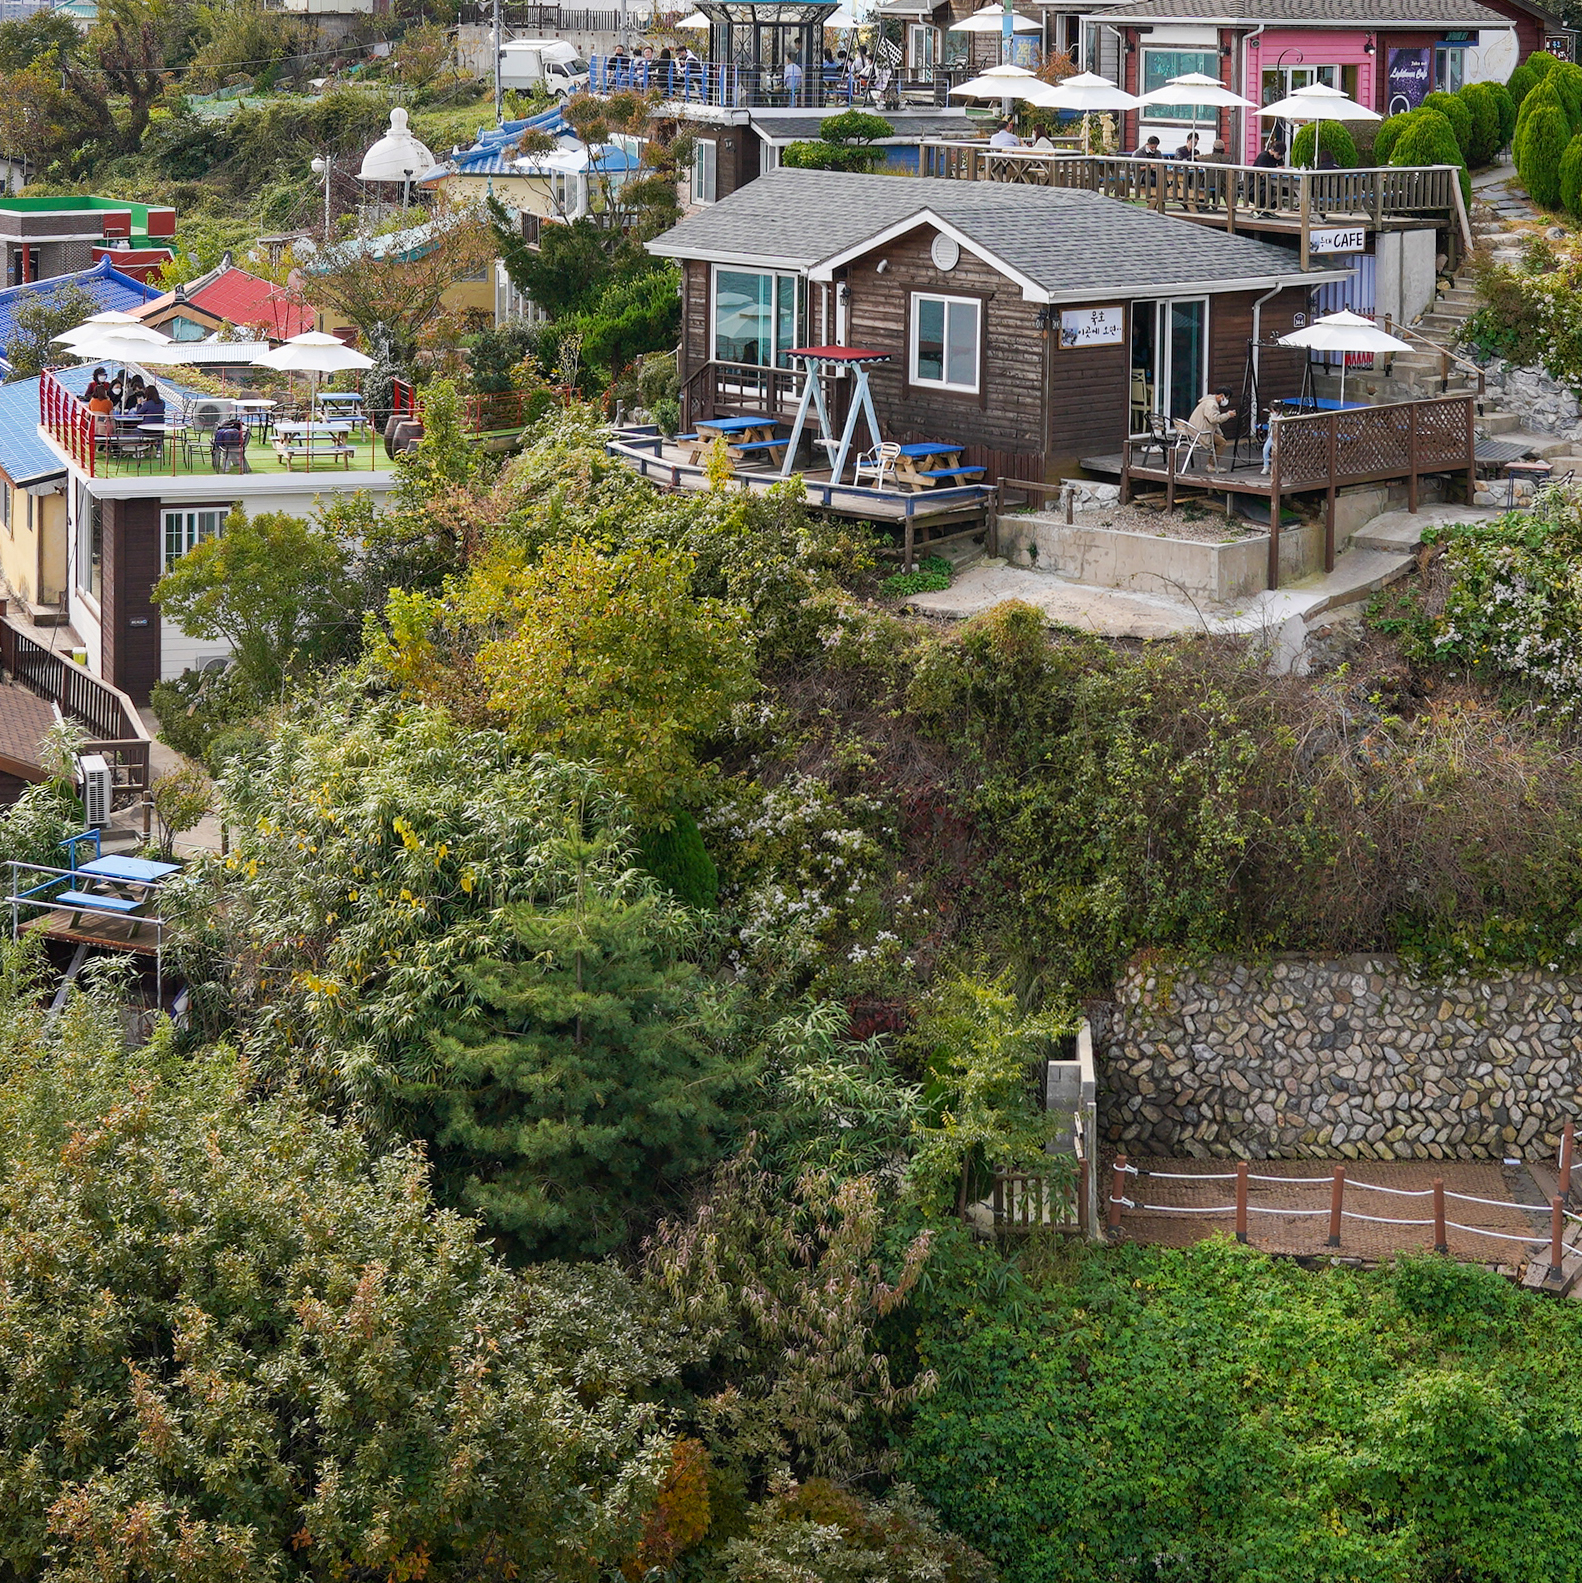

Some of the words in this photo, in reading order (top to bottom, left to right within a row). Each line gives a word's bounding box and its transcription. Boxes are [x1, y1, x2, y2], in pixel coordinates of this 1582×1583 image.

[1333, 232, 1363, 248] CAFE
[1090, 310, 1106, 326] 묵호
[1078, 325, 1100, 339] 이곳에
